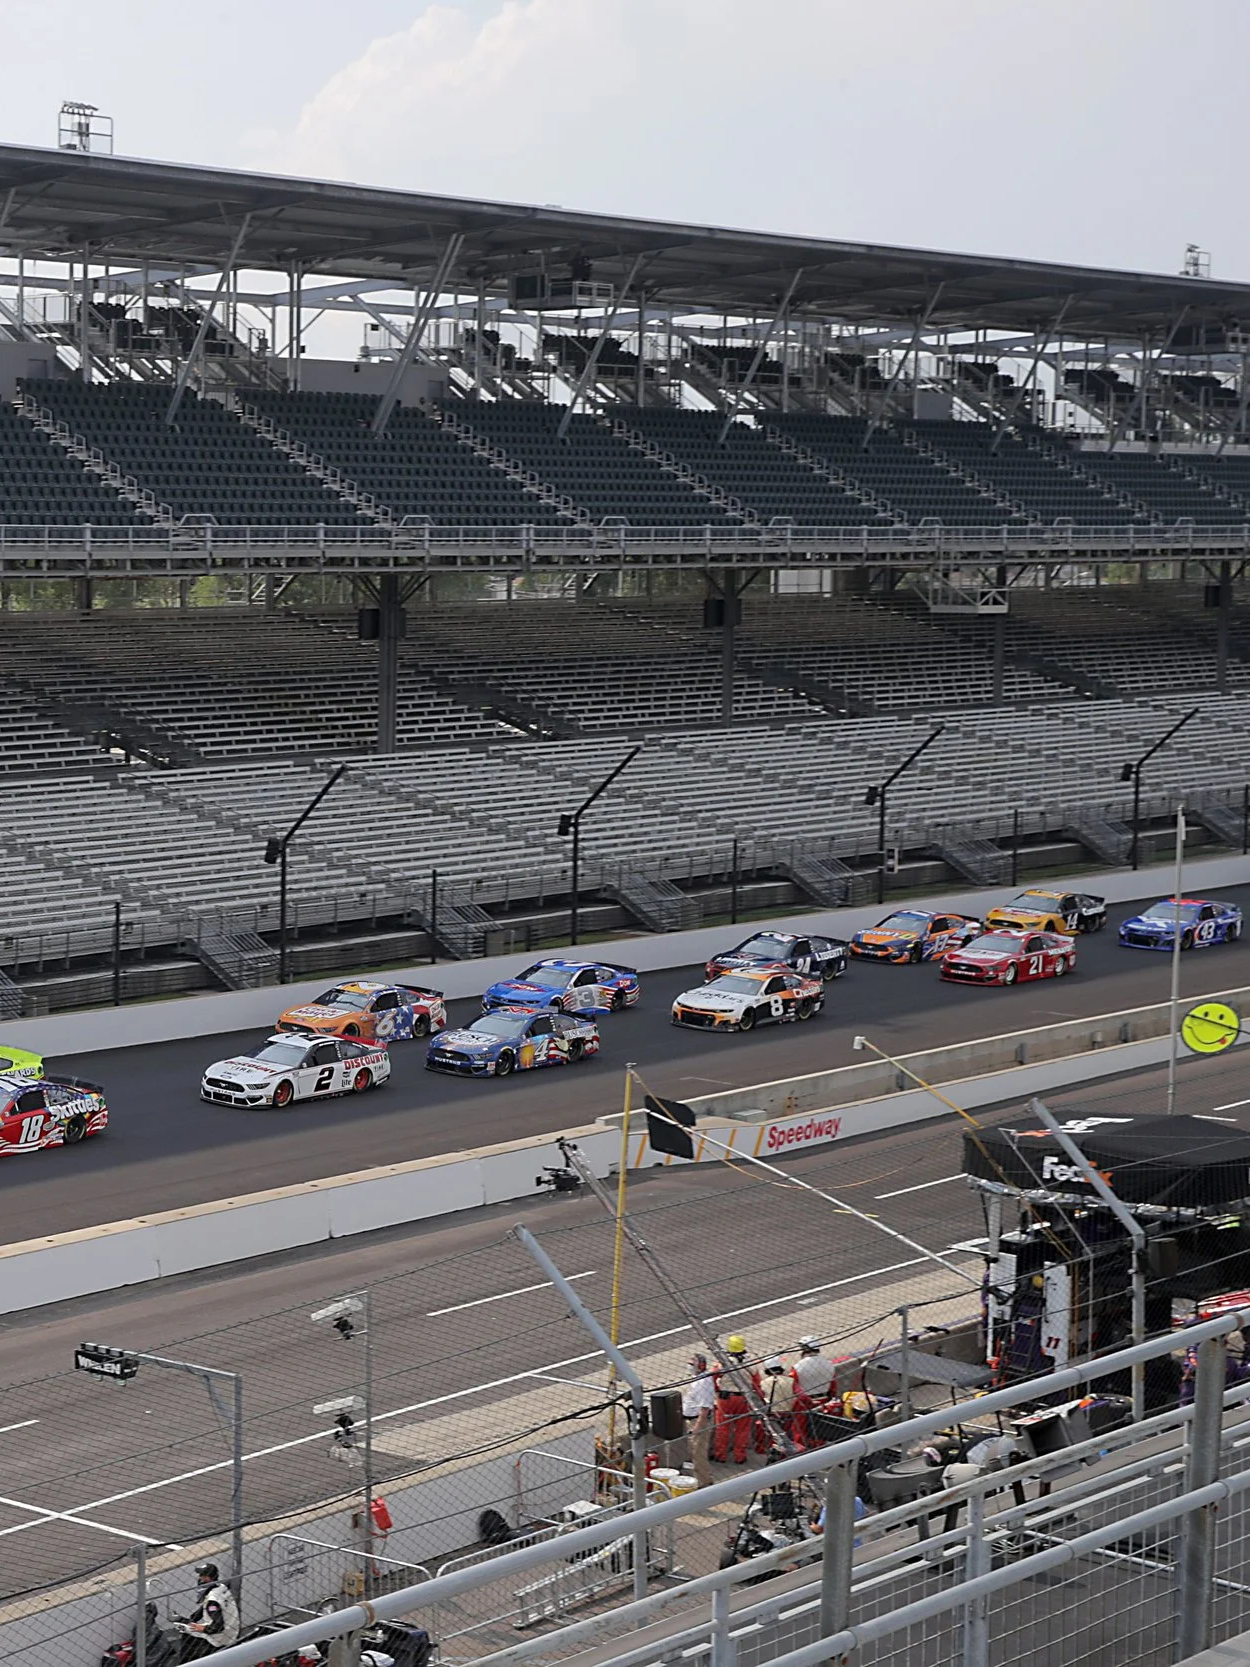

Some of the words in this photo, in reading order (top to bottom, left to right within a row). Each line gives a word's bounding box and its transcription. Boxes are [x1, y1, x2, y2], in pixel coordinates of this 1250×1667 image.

[1064, 913, 1079, 931] 14
[1200, 922, 1216, 940] 43
[932, 933, 950, 952] 17
[796, 957, 811, 974] 24
[1029, 955, 1043, 975] 21
[577, 985, 596, 1008] 3
[770, 994, 784, 1017] 8
[376, 1008, 398, 1038] 6
[534, 1039, 550, 1061] 4
[343, 1052, 384, 1070] DISCOUNT
[314, 1066, 335, 1092] 2
[19, 1114, 45, 1145] 18
[767, 1116, 842, 1151] Speedway
[1046, 1335, 1062, 1350] 11
